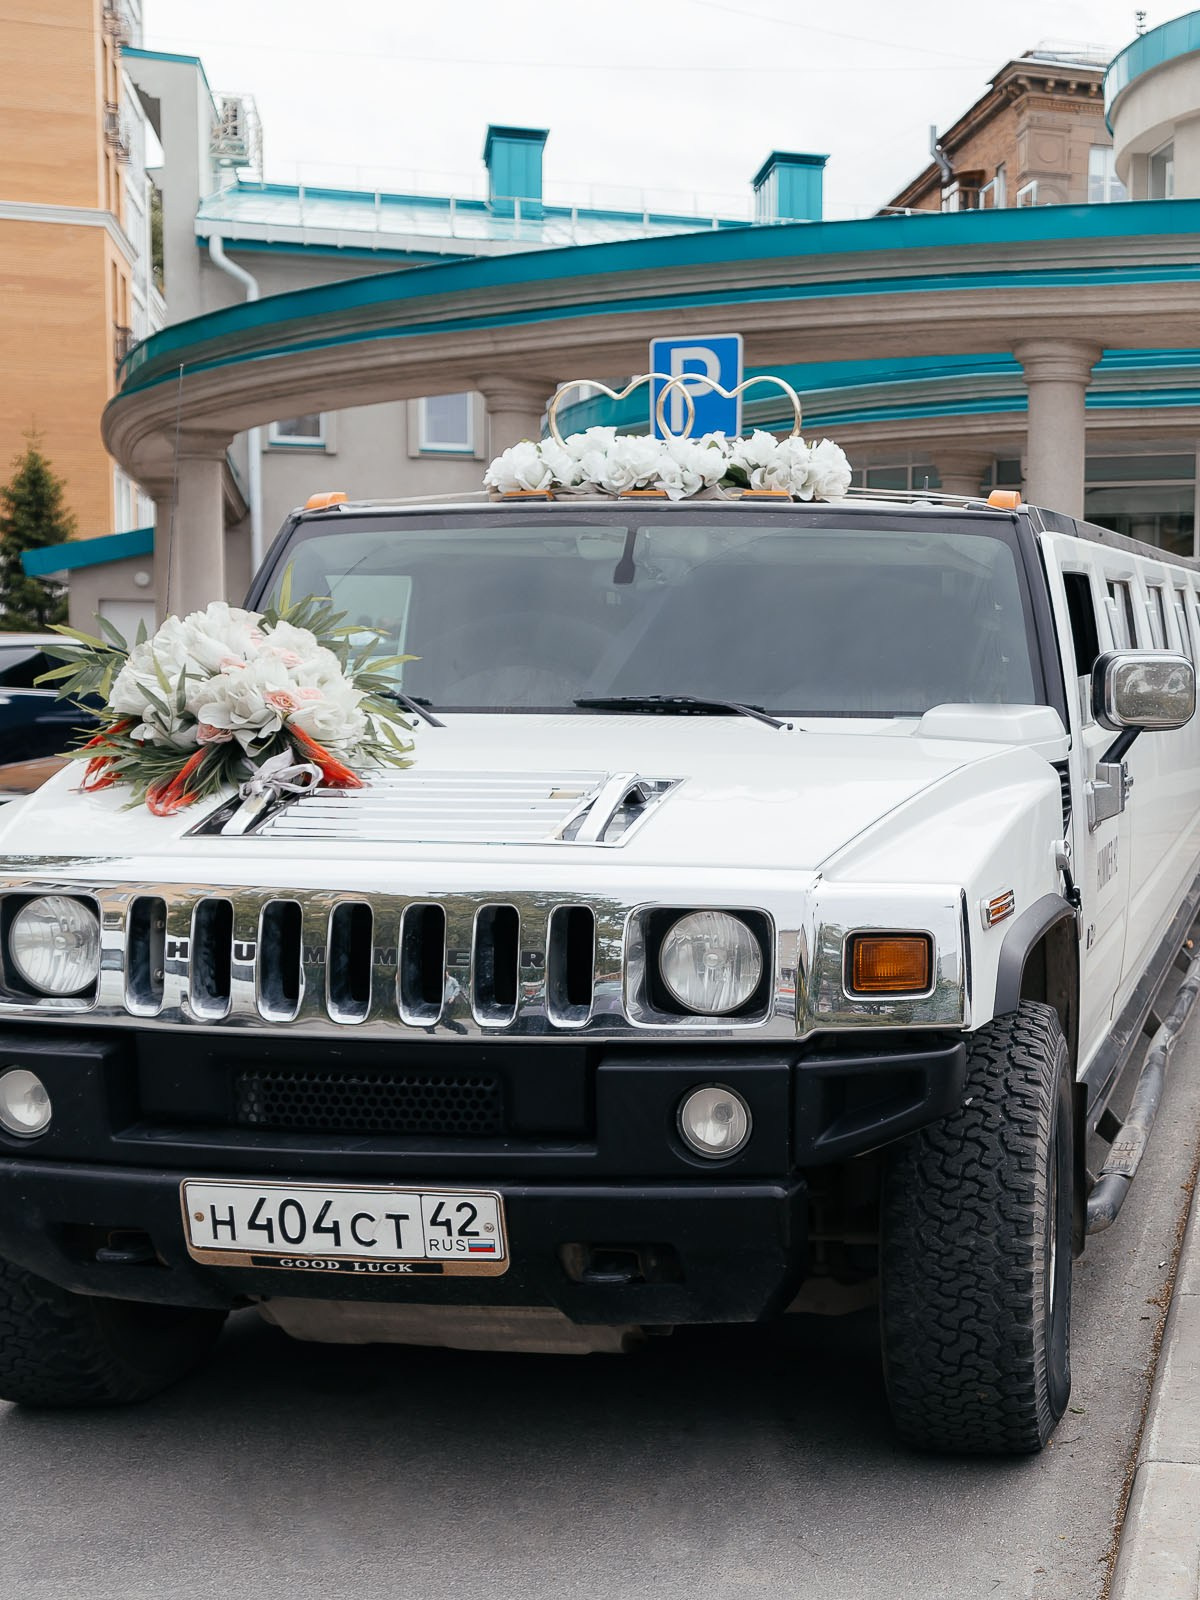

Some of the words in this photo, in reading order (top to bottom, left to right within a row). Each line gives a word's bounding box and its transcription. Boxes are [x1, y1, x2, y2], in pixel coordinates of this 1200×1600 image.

[670, 346, 721, 432] P
[167, 939, 544, 969] HUMMER
[429, 1201, 480, 1237] 42
[429, 1238, 466, 1251] RUS
[279, 1259, 340, 1270] GOOD
[353, 1262, 413, 1273] LUCK
